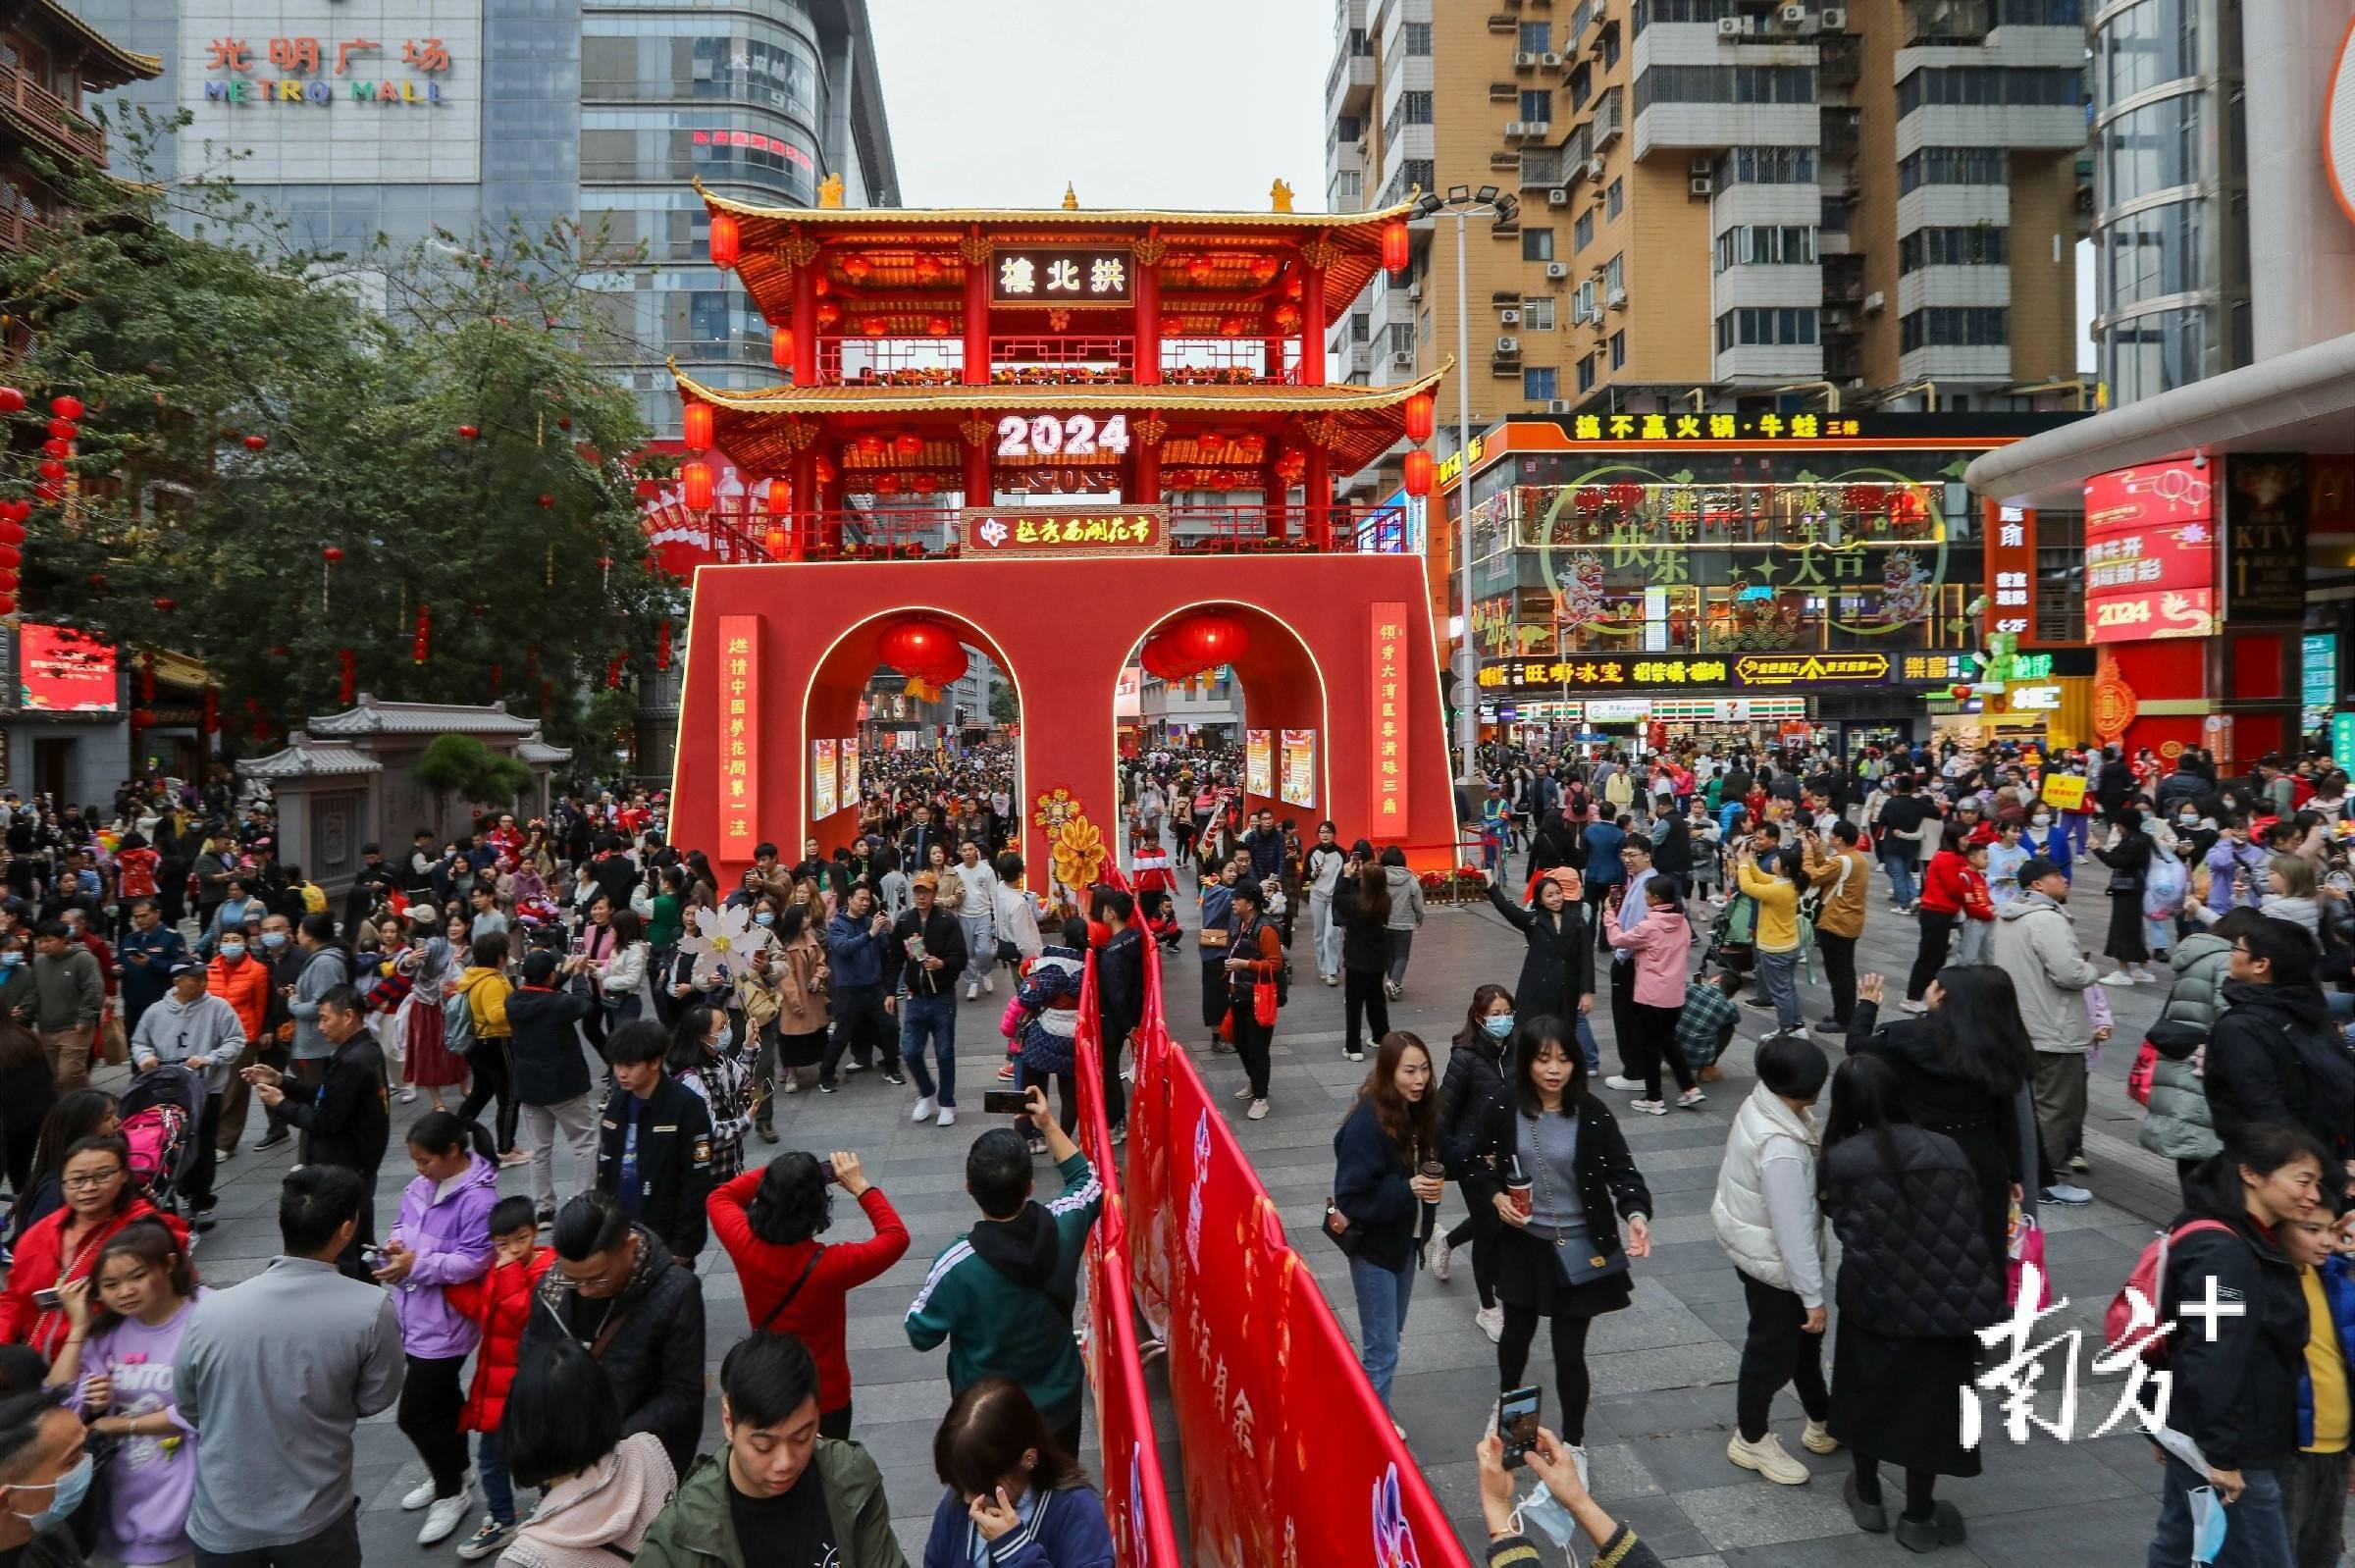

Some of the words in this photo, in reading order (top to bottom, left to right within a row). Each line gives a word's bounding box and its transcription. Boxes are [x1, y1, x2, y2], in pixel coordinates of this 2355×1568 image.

[205, 36, 449, 75] 光明广场
[205, 79, 331, 103] METRO
[350, 78, 450, 102] MALL
[997, 414, 1130, 456] 2024
[1016, 516, 1150, 544] 越秀西湖花市
[2097, 600, 2152, 627] 2024
